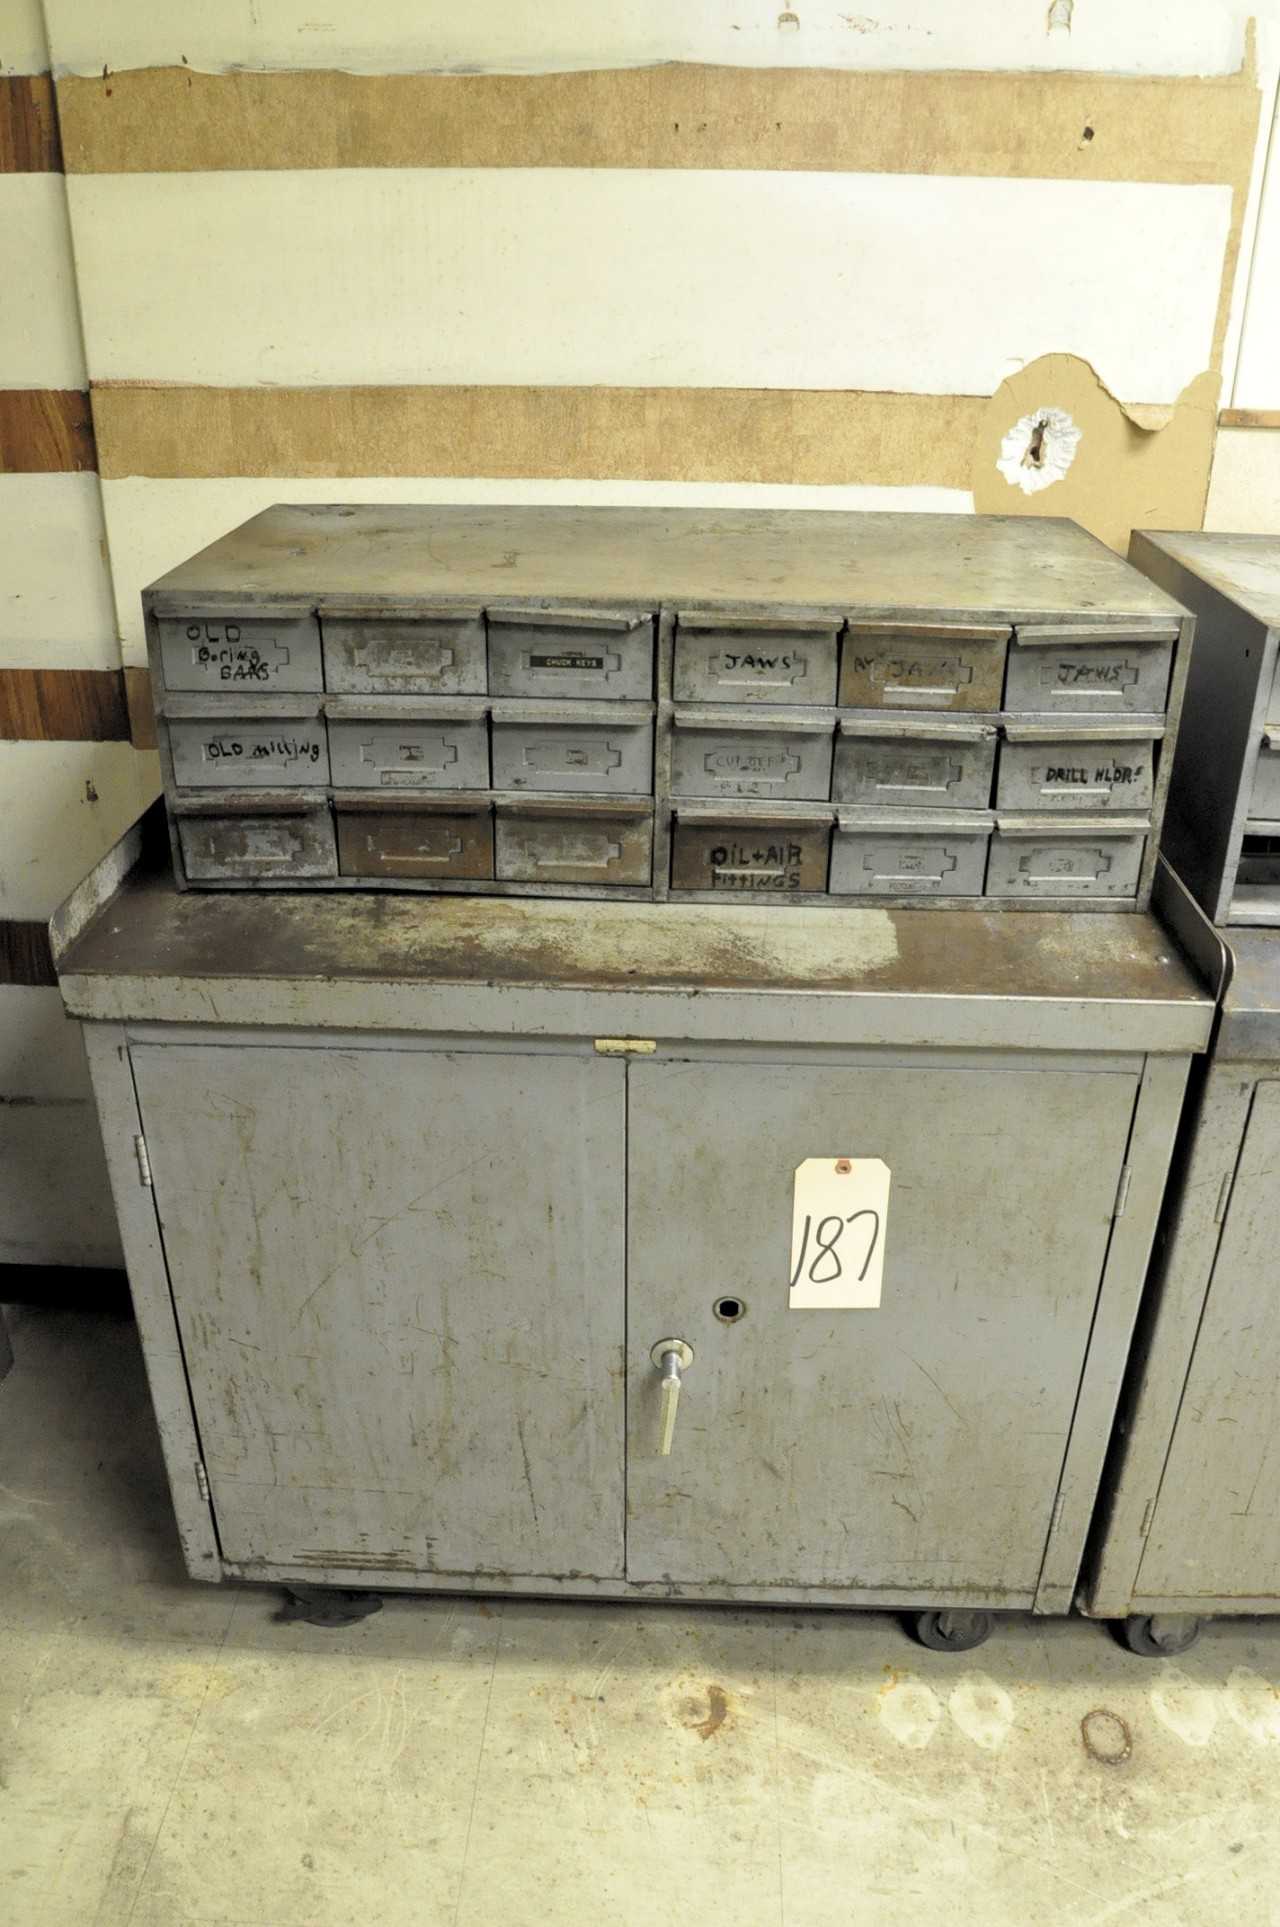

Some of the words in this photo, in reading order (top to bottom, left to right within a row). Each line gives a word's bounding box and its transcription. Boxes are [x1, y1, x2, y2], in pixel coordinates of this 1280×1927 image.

[186, 623, 241, 643] OLD
[724, 653, 792, 670] JAWS
[208, 742, 243, 758] OLD
[1046, 766, 1088, 785] DRILL
[789, 1209, 880, 1288] 187
